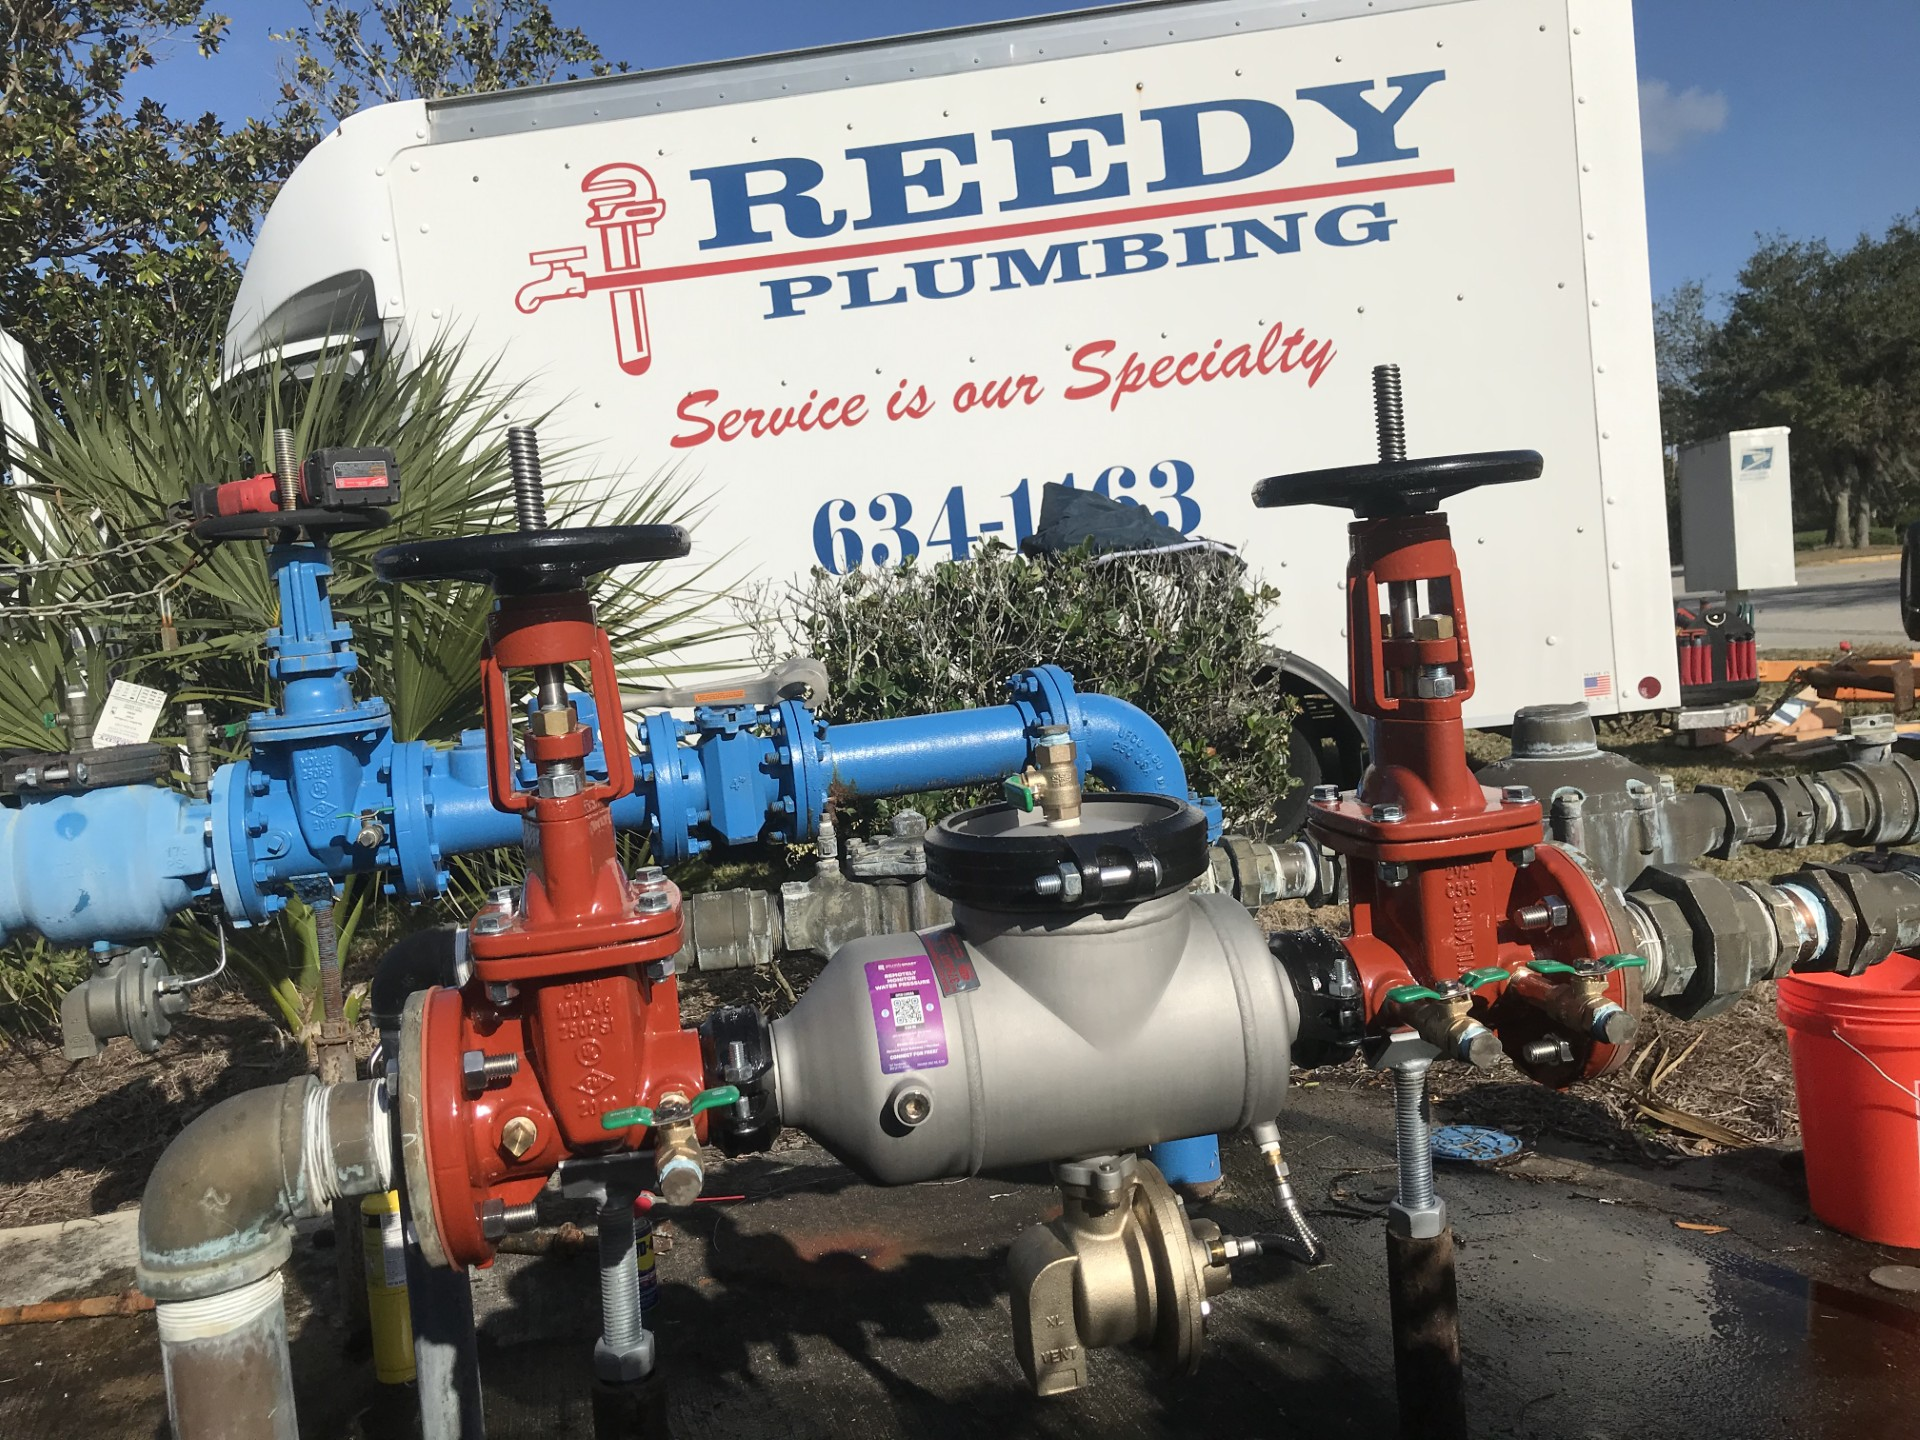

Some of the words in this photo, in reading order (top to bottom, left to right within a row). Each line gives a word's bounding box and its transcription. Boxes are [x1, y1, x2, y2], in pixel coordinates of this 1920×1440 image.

[690, 70, 1446, 250] REEDY
[761, 201, 1398, 319] PLUMBING
[670, 389, 869, 448] Service
[887, 378, 936, 421] is
[952, 374, 1044, 413] our
[1064, 321, 1337, 412] Specialty
[884, 970, 917, 979] REMOTELY
[886, 975, 917, 984] MONITOR
[875, 983, 897, 991] WATER
[898, 979, 930, 987] PRESSURE
[1041, 1345, 1077, 1364] VENT
